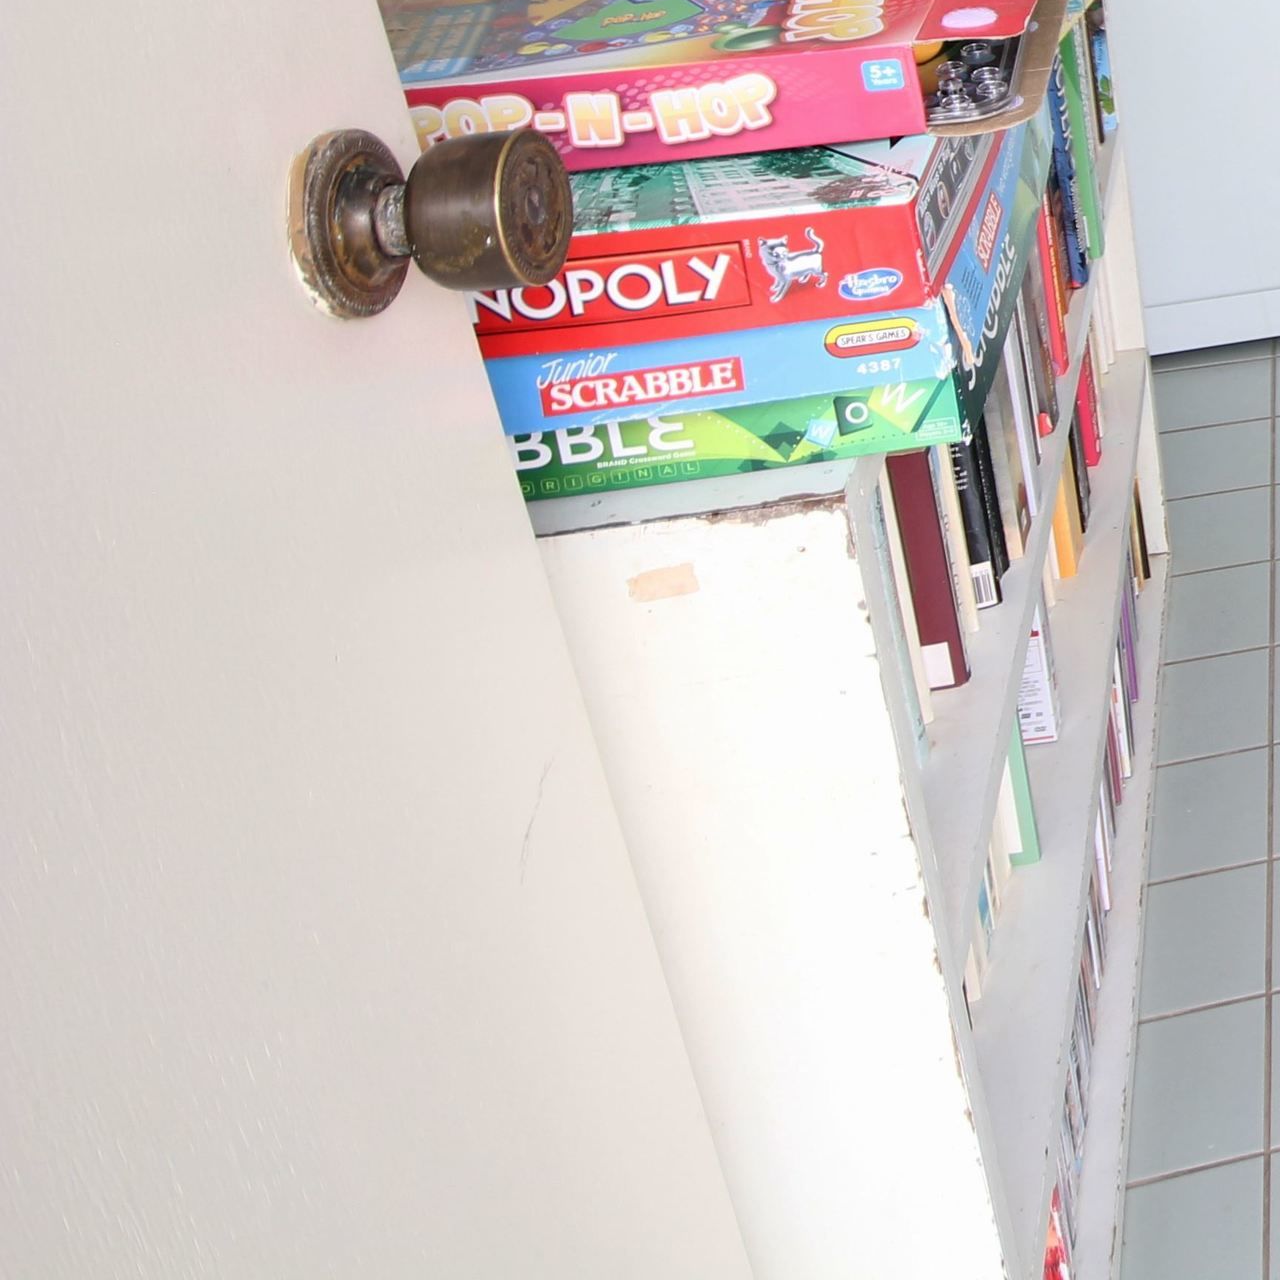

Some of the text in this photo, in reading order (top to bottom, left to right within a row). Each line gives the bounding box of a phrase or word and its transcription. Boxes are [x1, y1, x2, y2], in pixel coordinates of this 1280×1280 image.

[869, 64, 897, 78] 5+
[975, 193, 1002, 271] SCRABBLE
[463, 253, 731, 324] NOPOLY
[845, 271, 898, 289] Hasbro
[840, 328, 907, 346] SPEAR'S GAMES
[536, 351, 619, 389] Junior
[855, 357, 901, 375] 4387
[550, 363, 738, 412] SCRABBLE
[512, 412, 696, 471] BBLE
[596, 449, 696, 469] BRAND Crossword Game
